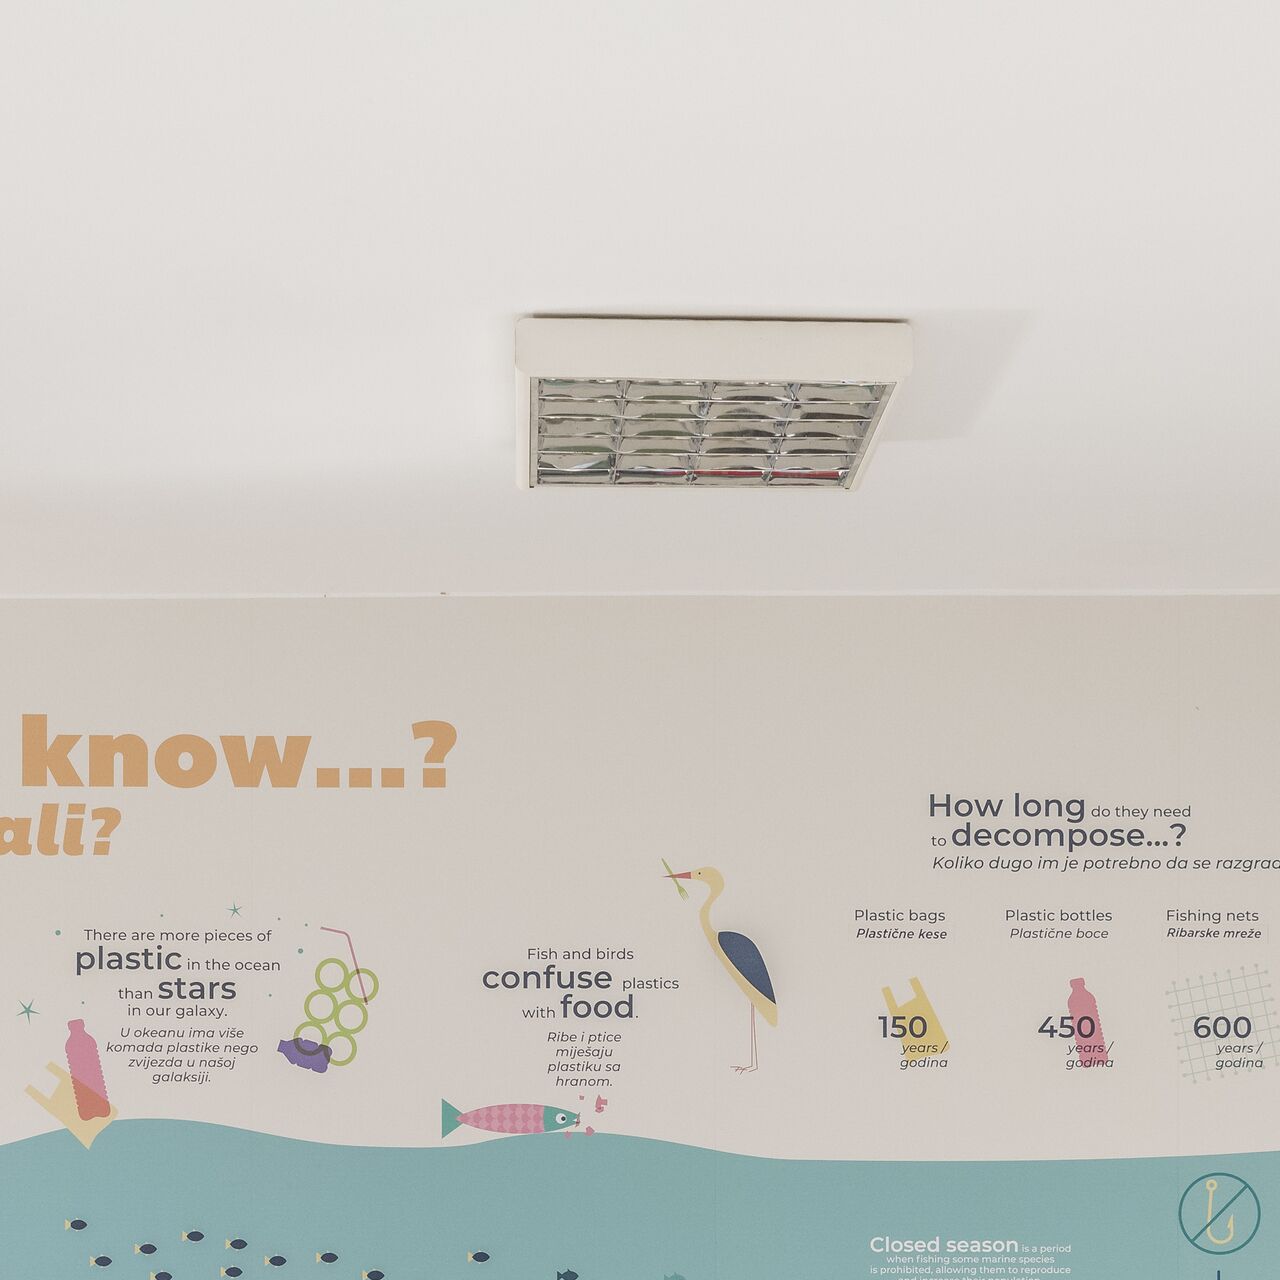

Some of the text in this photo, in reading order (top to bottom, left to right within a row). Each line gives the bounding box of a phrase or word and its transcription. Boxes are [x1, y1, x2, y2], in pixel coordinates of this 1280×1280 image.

[929, 792, 1192, 824] How long do they need
[930, 835, 948, 847] to
[932, 855, 985, 870] Koliko
[988, 855, 1034, 873] dugo
[1037, 855, 1060, 870] im
[1060, 855, 1079, 873] je
[1082, 855, 1162, 873] potrebno
[1165, 855, 1189, 870] da
[1191, 858, 1212, 870] se
[854, 908, 946, 925] Plastic bags
[1005, 908, 1113, 922] Plastic bottles
[1166, 908, 1260, 925] Fishing nets
[83, 928, 273, 945] There are more pieces of
[855, 927, 948, 940] Plastične kese
[1009, 927, 1110, 940] Plastične boce
[1166, 926, 1262, 940] Ribarske mreže
[75, 944, 281, 977] plastic in the ocean
[527, 946, 635, 961] Fish and birds
[482, 963, 680, 993] confuse plastics
[117, 977, 237, 1001] than stars
[127, 1003, 228, 1020] in our galaxy.
[521, 993, 639, 1019] with food.
[120, 1026, 245, 1039] U okeanu ima više
[877, 1015, 928, 1039] 150
[1037, 1015, 1096, 1040] 450
[1193, 1015, 1252, 1040] 600
[555, 1045, 614, 1061] miješaju
[546, 1060, 622, 1075] plastiku sa
[899, 1056, 949, 1071] godina
[1064, 1056, 1115, 1071] godina
[1214, 1056, 1264, 1071] godina
[151, 1070, 212, 1086] galaksiji.
[555, 1075, 613, 1088] hranom.
[869, 1235, 1072, 1255] Closed season is a period
